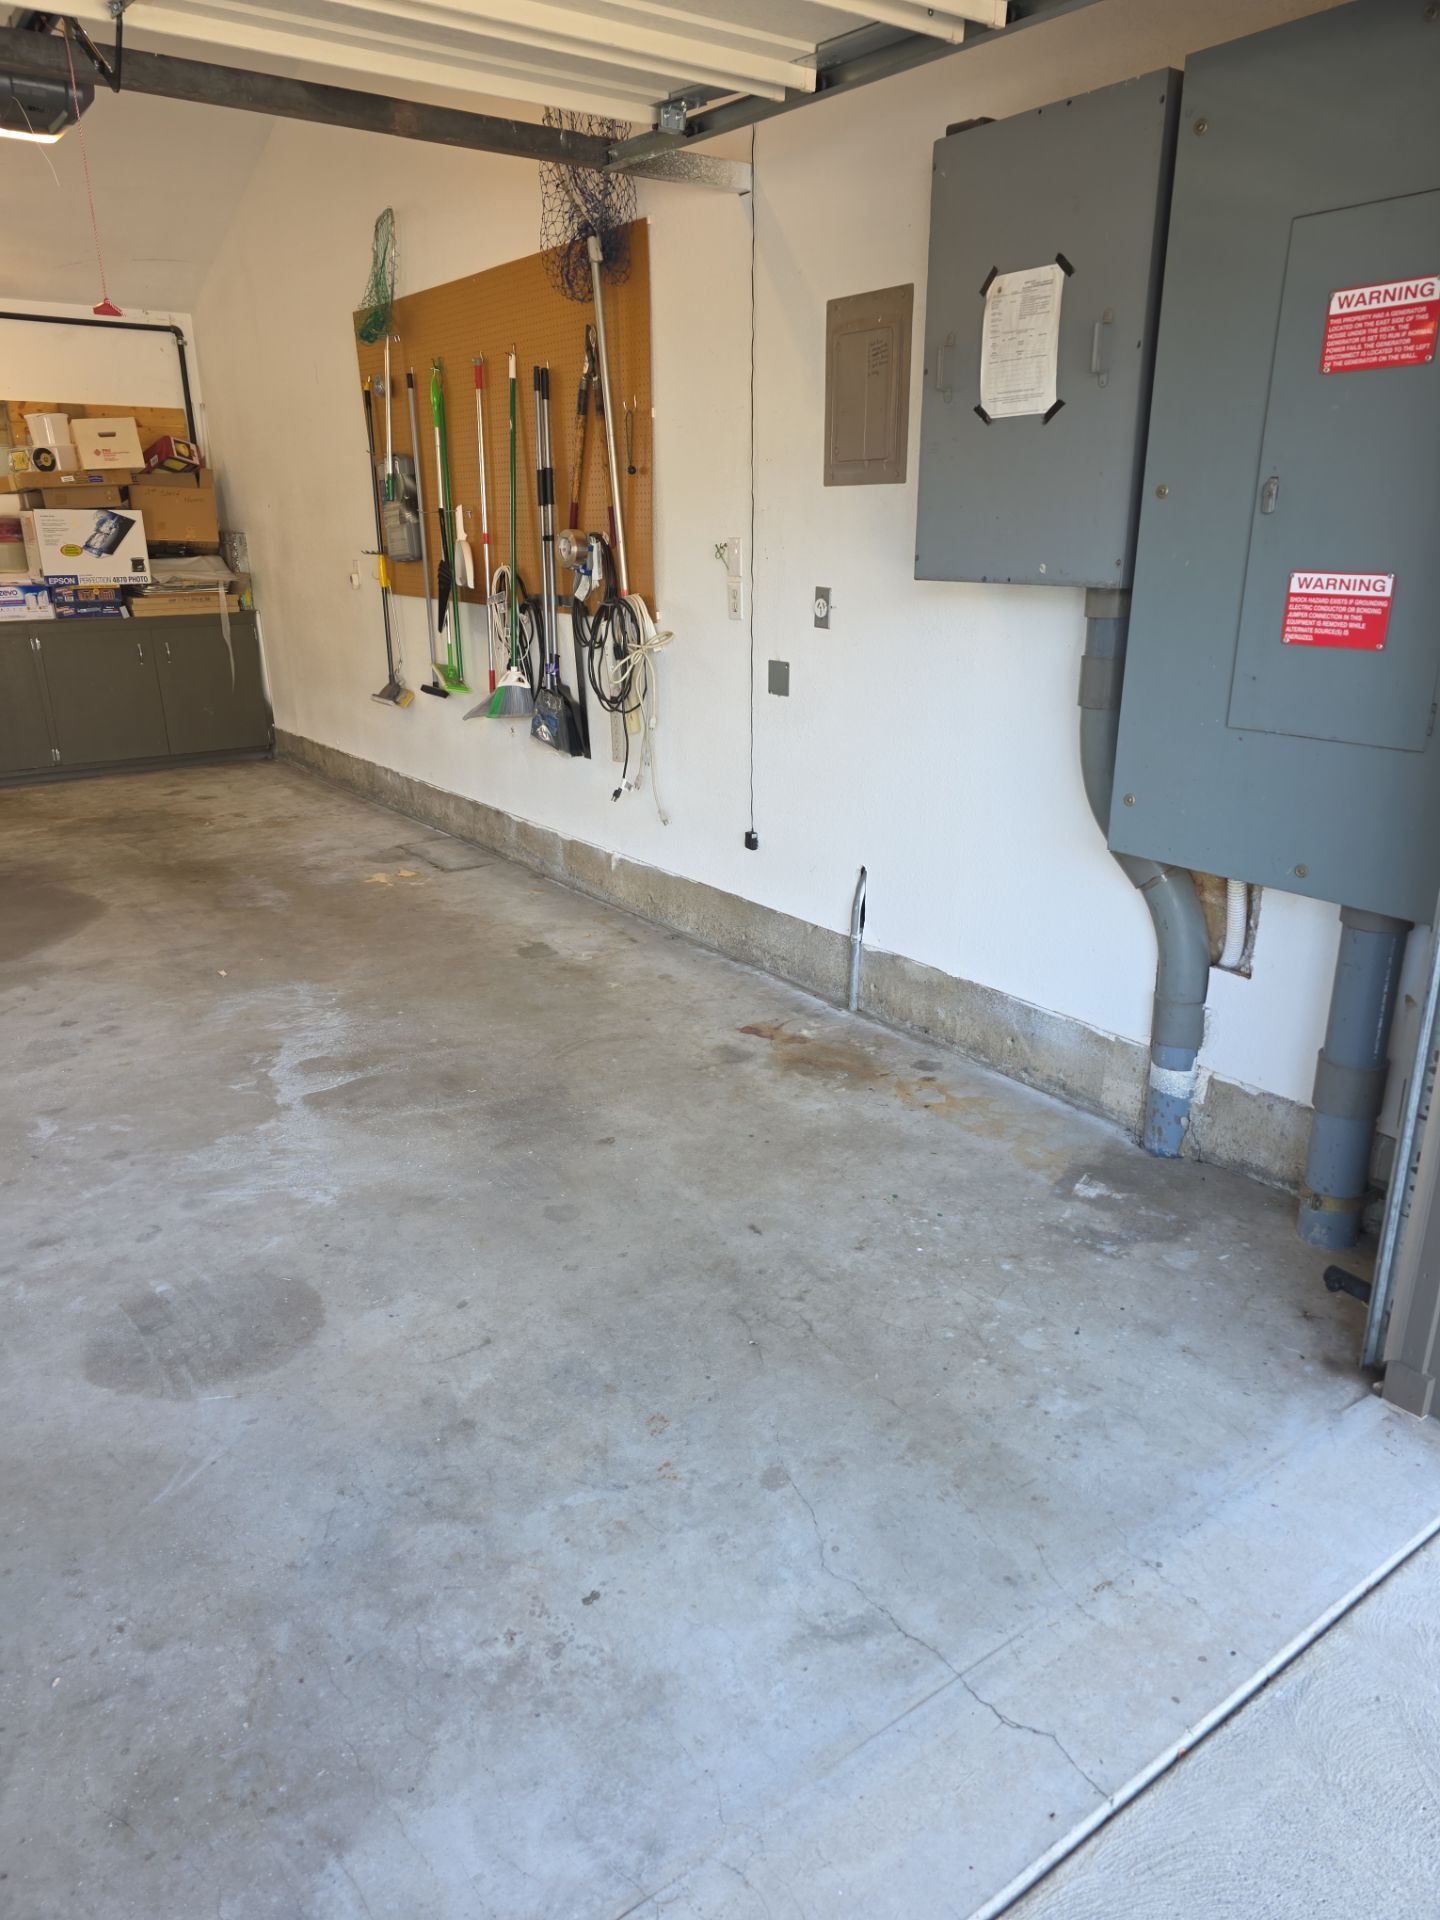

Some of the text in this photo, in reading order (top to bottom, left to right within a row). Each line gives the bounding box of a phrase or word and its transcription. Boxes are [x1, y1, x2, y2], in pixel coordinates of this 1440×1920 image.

[1338, 282, 1435, 310] WARNING
[1342, 314, 1372, 324] PROPERTY
[1391, 306, 1427, 317] GENERATOR
[1328, 324, 1354, 333] LOCATED
[1326, 338, 1360, 347] GENERATOR
[1376, 338, 1411, 348] GENERATOR
[1324, 352, 1360, 361] DISCONNECT
[1367, 348, 1393, 356] LOCATED
[1344, 357, 1378, 366] GENERATOR
[49, 577, 76, 585] EPSON
[1298, 577, 1386, 592] WARNING
